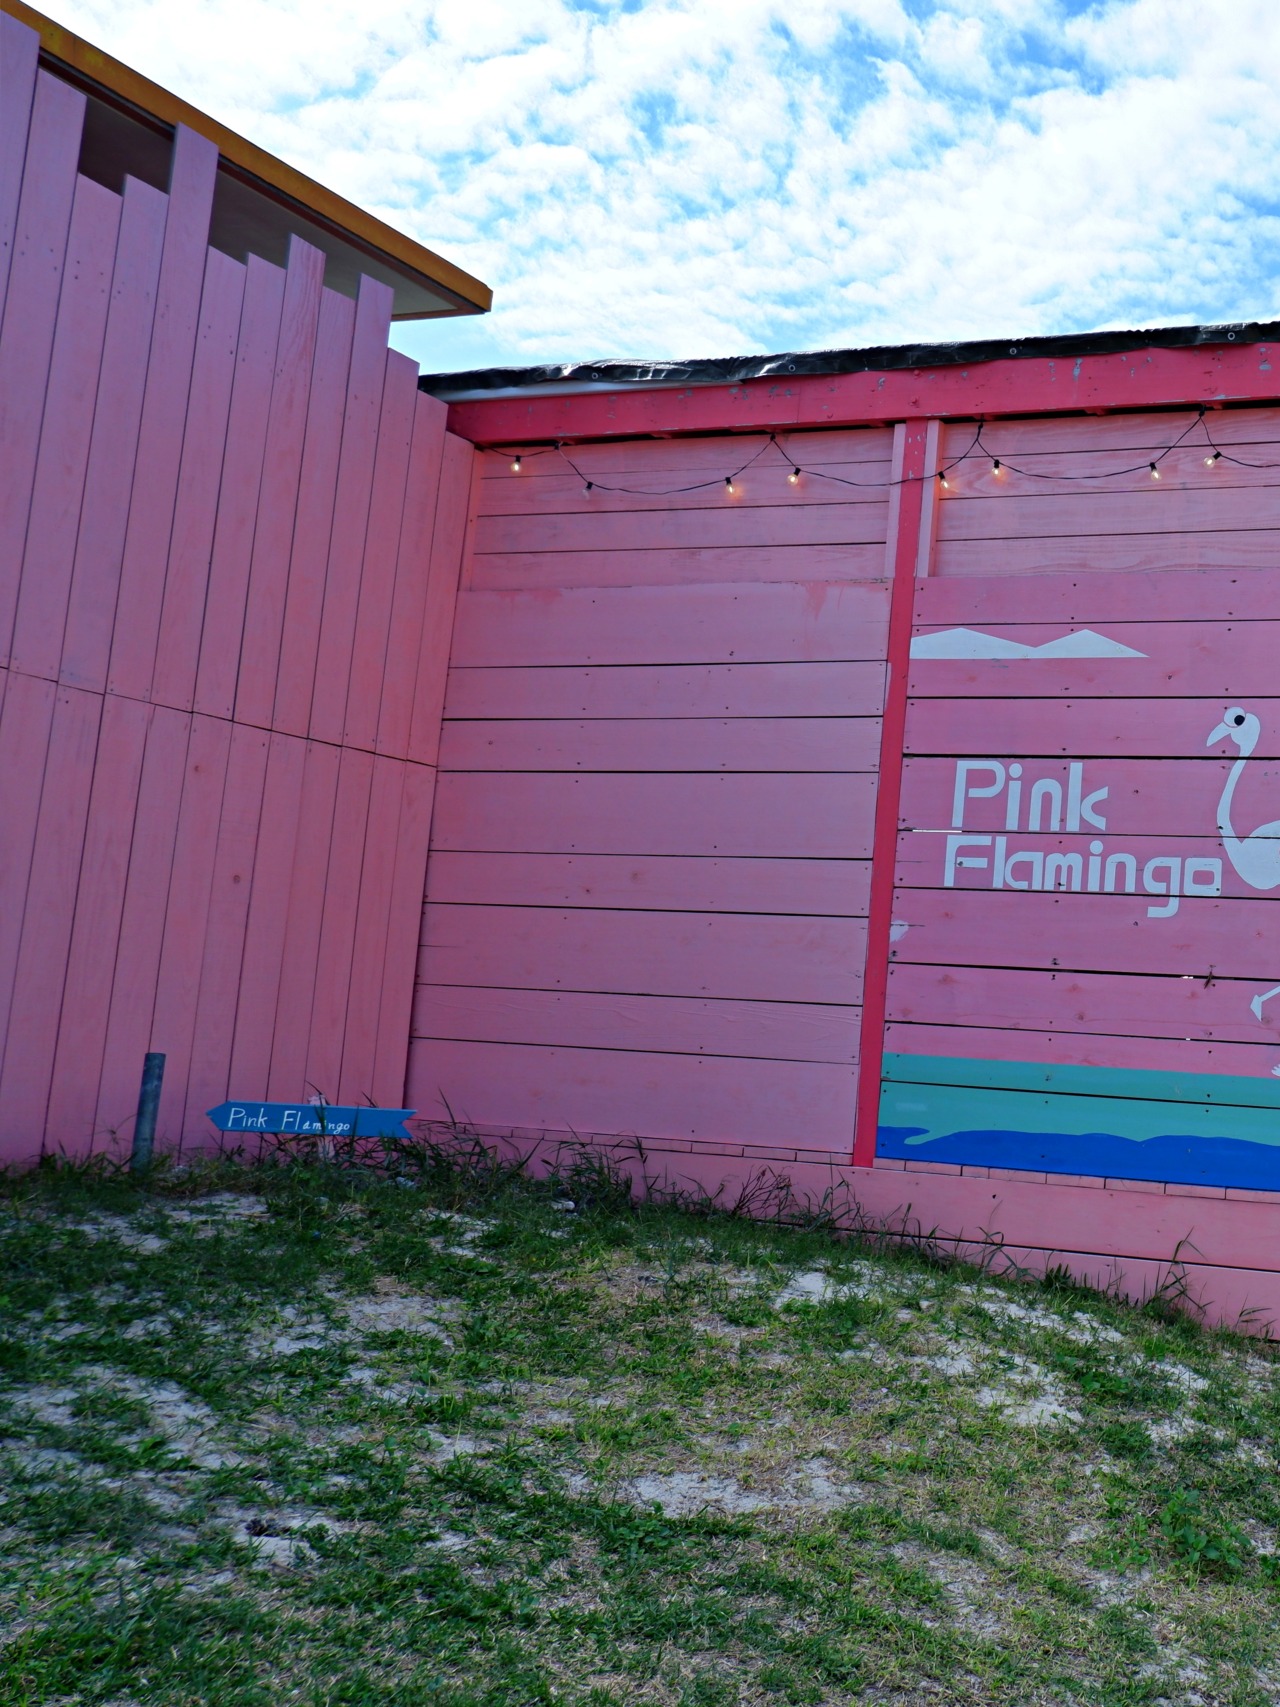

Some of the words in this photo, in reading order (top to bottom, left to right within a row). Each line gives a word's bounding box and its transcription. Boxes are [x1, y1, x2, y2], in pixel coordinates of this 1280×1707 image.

[952, 760, 1109, 832] Pink
[944, 834, 1222, 918] Flamingo
[227, 1107, 268, 1128] Pink
[281, 1109, 350, 1135] Flamingo
